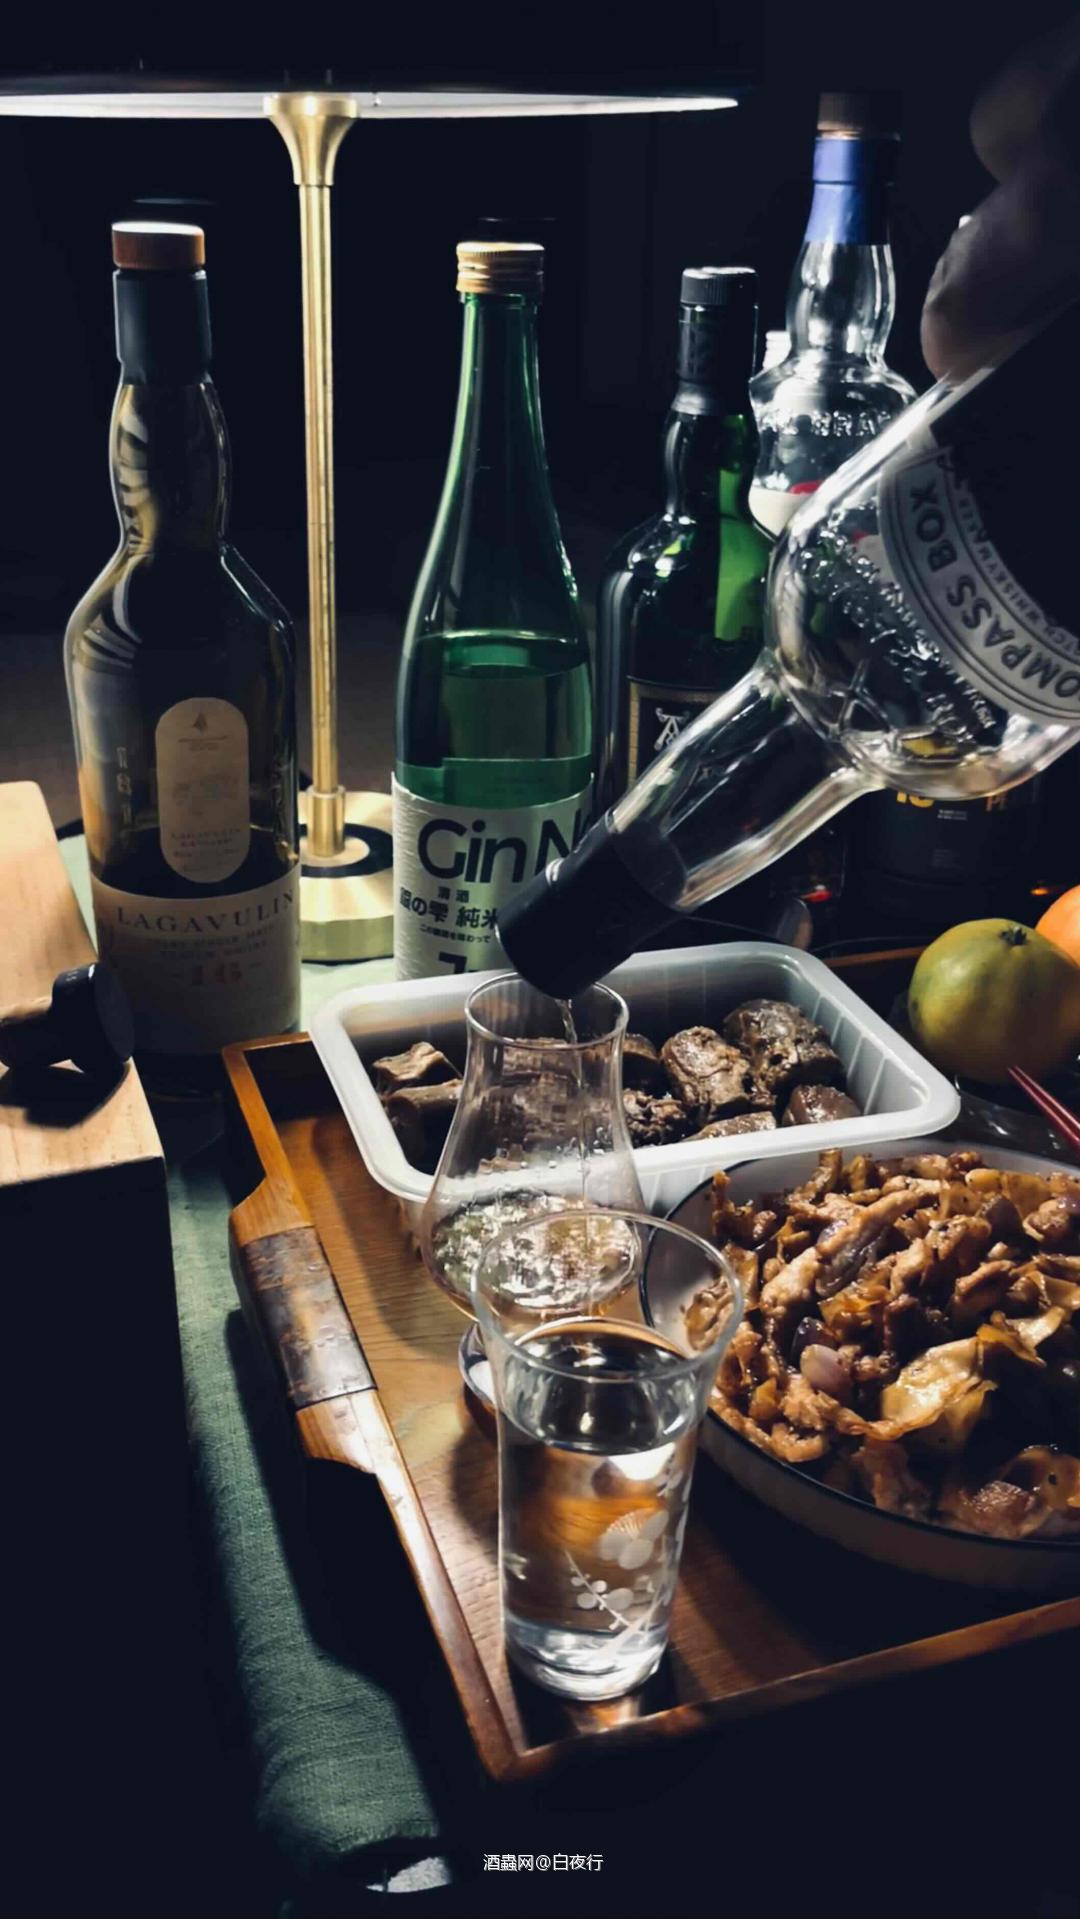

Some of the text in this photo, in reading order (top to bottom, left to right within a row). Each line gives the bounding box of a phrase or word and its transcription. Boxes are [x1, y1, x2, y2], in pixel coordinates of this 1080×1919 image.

[909, 484, 1080, 698] OMPASS BOX
[117, 890, 293, 932] LAGAVULIN
